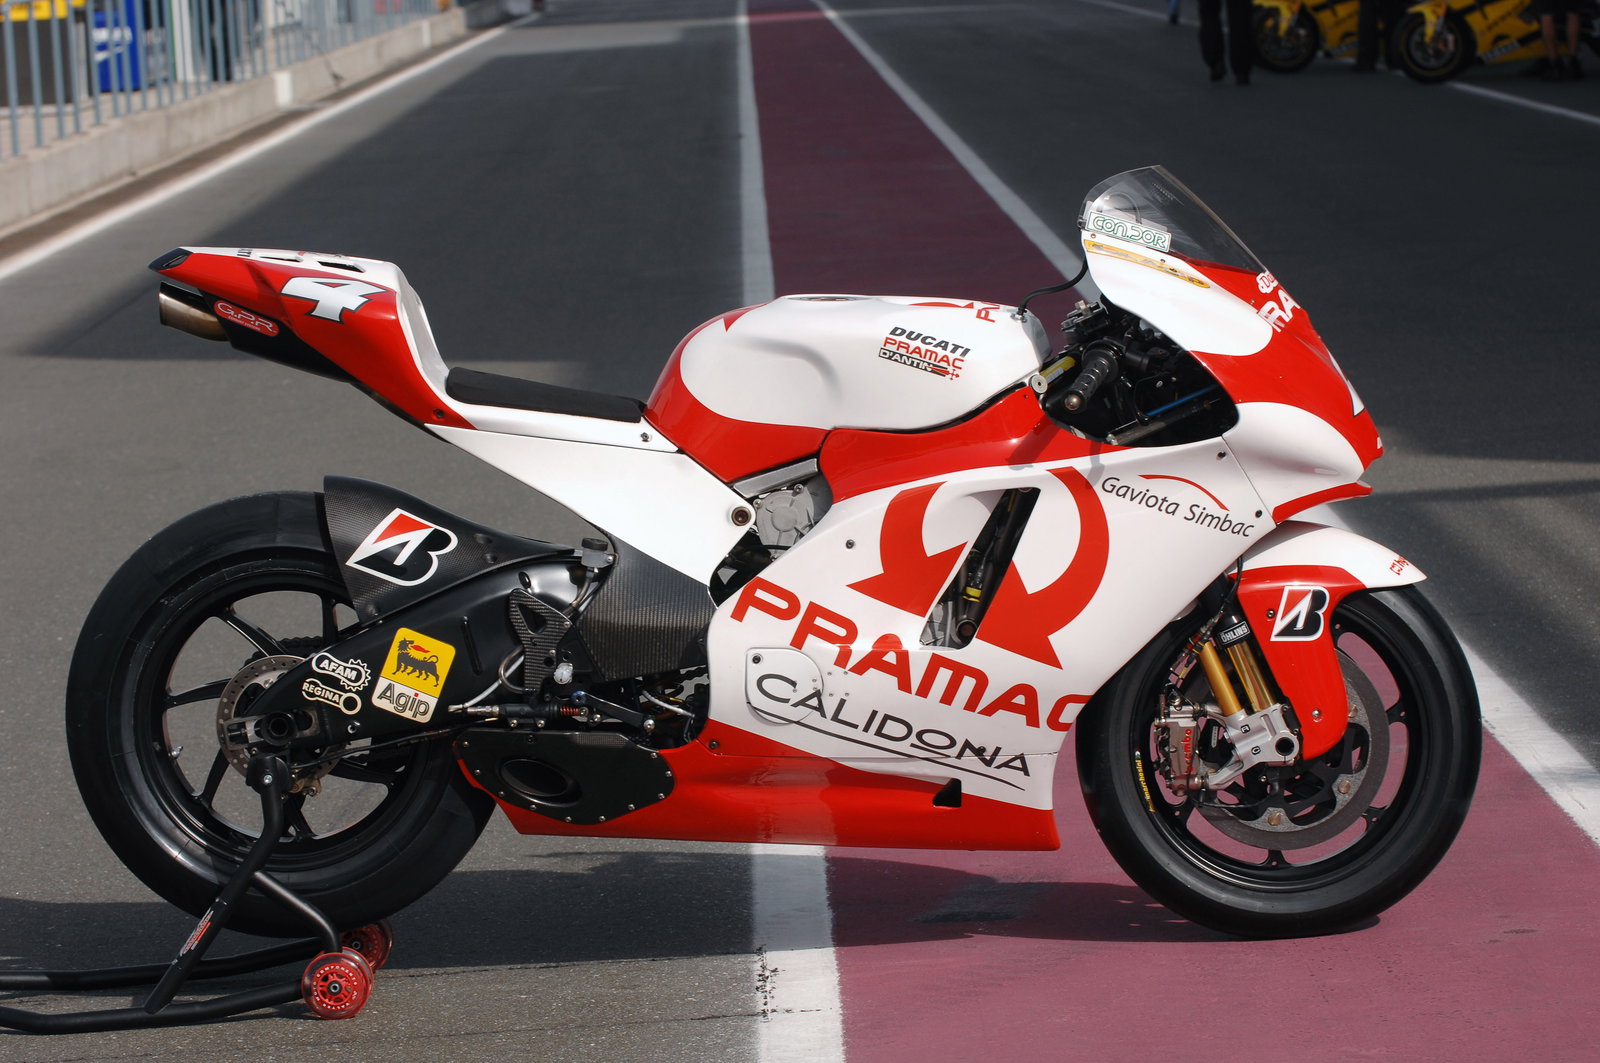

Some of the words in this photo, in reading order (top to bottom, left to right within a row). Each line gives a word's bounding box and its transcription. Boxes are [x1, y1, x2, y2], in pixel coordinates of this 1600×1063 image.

[280, 276, 389, 325] 4
[879, 348, 933, 372] D'ANTIN
[882, 336, 965, 370] PRAMAC
[888, 326, 971, 358] DUCATI
[1100, 475, 1180, 517] Gaviota
[1183, 503, 1257, 538] Simbac
[319, 658, 358, 681] AFAM
[730, 575, 1092, 732] PRAMAC
[301, 681, 340, 703] REGINA
[377, 682, 431, 720] Agip
[755, 672, 1030, 778] CALIDONA
